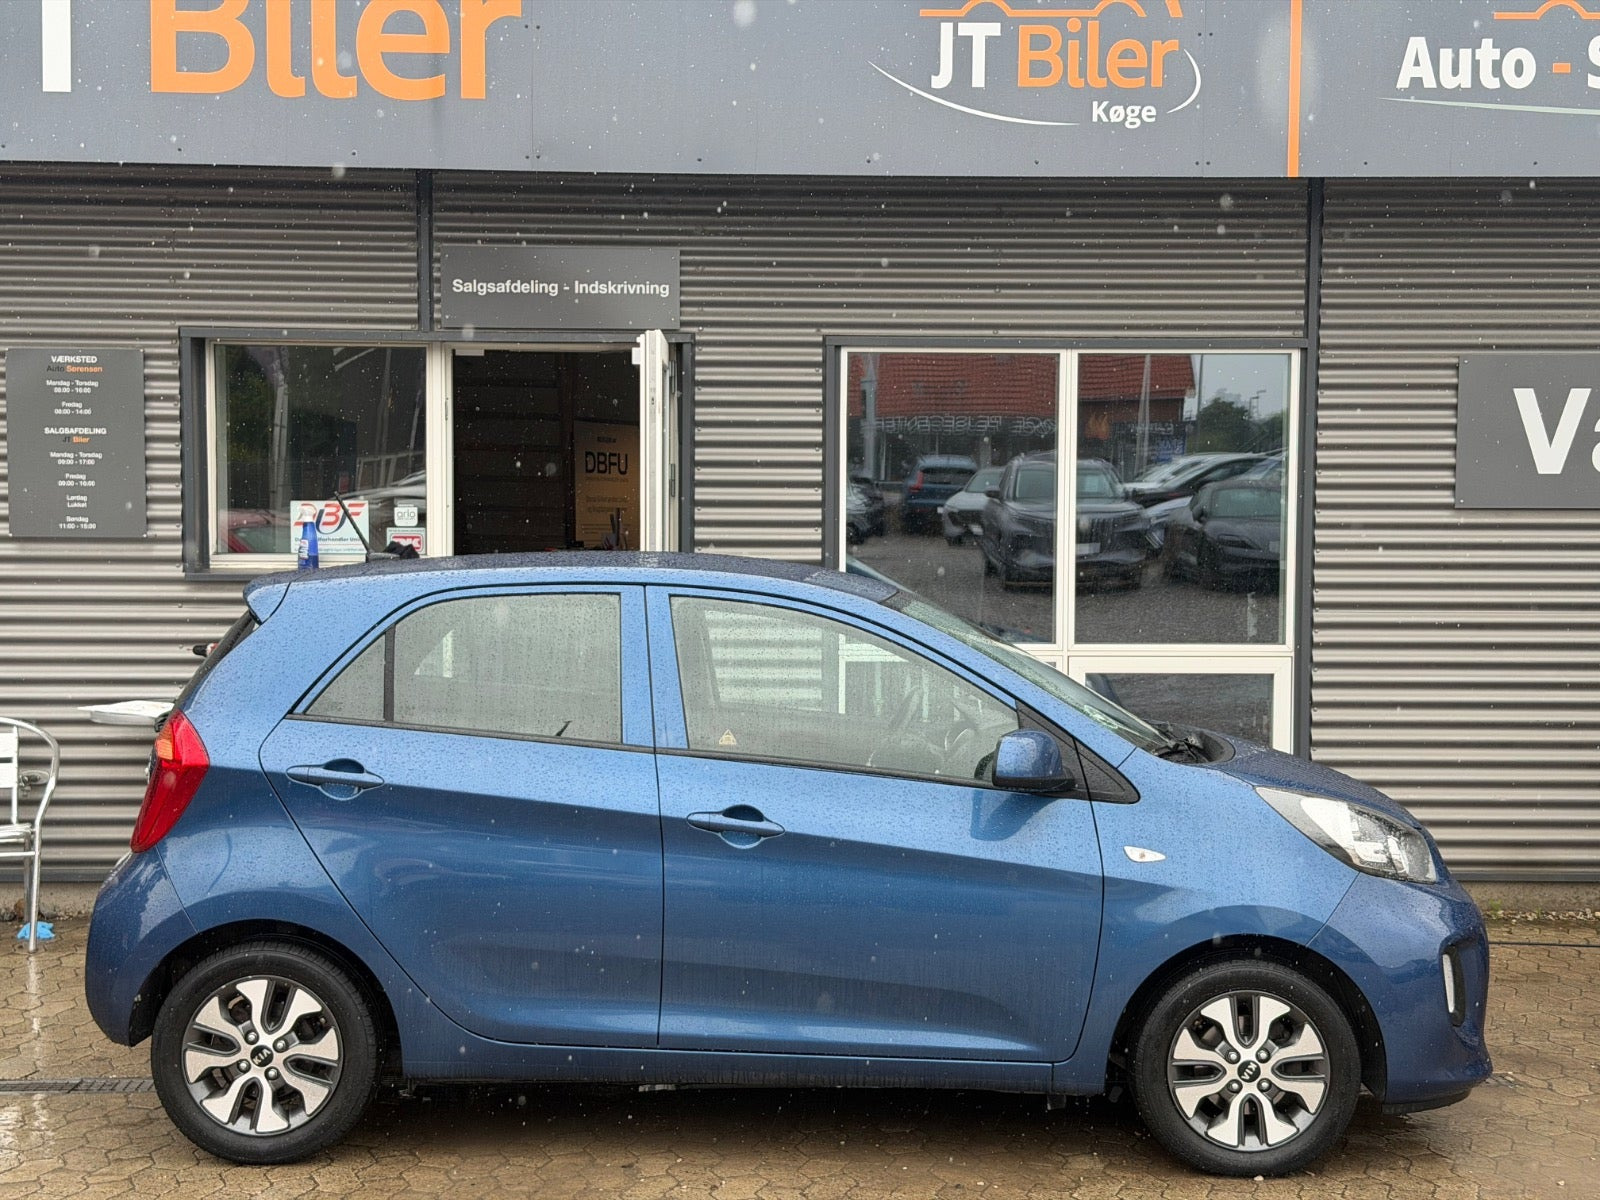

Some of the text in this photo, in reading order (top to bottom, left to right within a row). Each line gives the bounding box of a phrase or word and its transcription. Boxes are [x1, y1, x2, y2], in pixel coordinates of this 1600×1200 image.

[930, 17, 1179, 89] JT Biler
[1396, 36, 1537, 89] Auto
[1091, 100, 1157, 129] Køge
[452, 279, 559, 297] Salgsafdeling
[574, 280, 670, 297] Indskrivning
[51, 355, 98, 363] VÆRKSTED
[44, 427, 107, 435] SALGSAFDELING
[1512, 387, 1600, 475] V
[585, 451, 629, 475] DBFU
[252, 1048, 271, 1065] KIA
[1241, 1063, 1258, 1080] KIA
